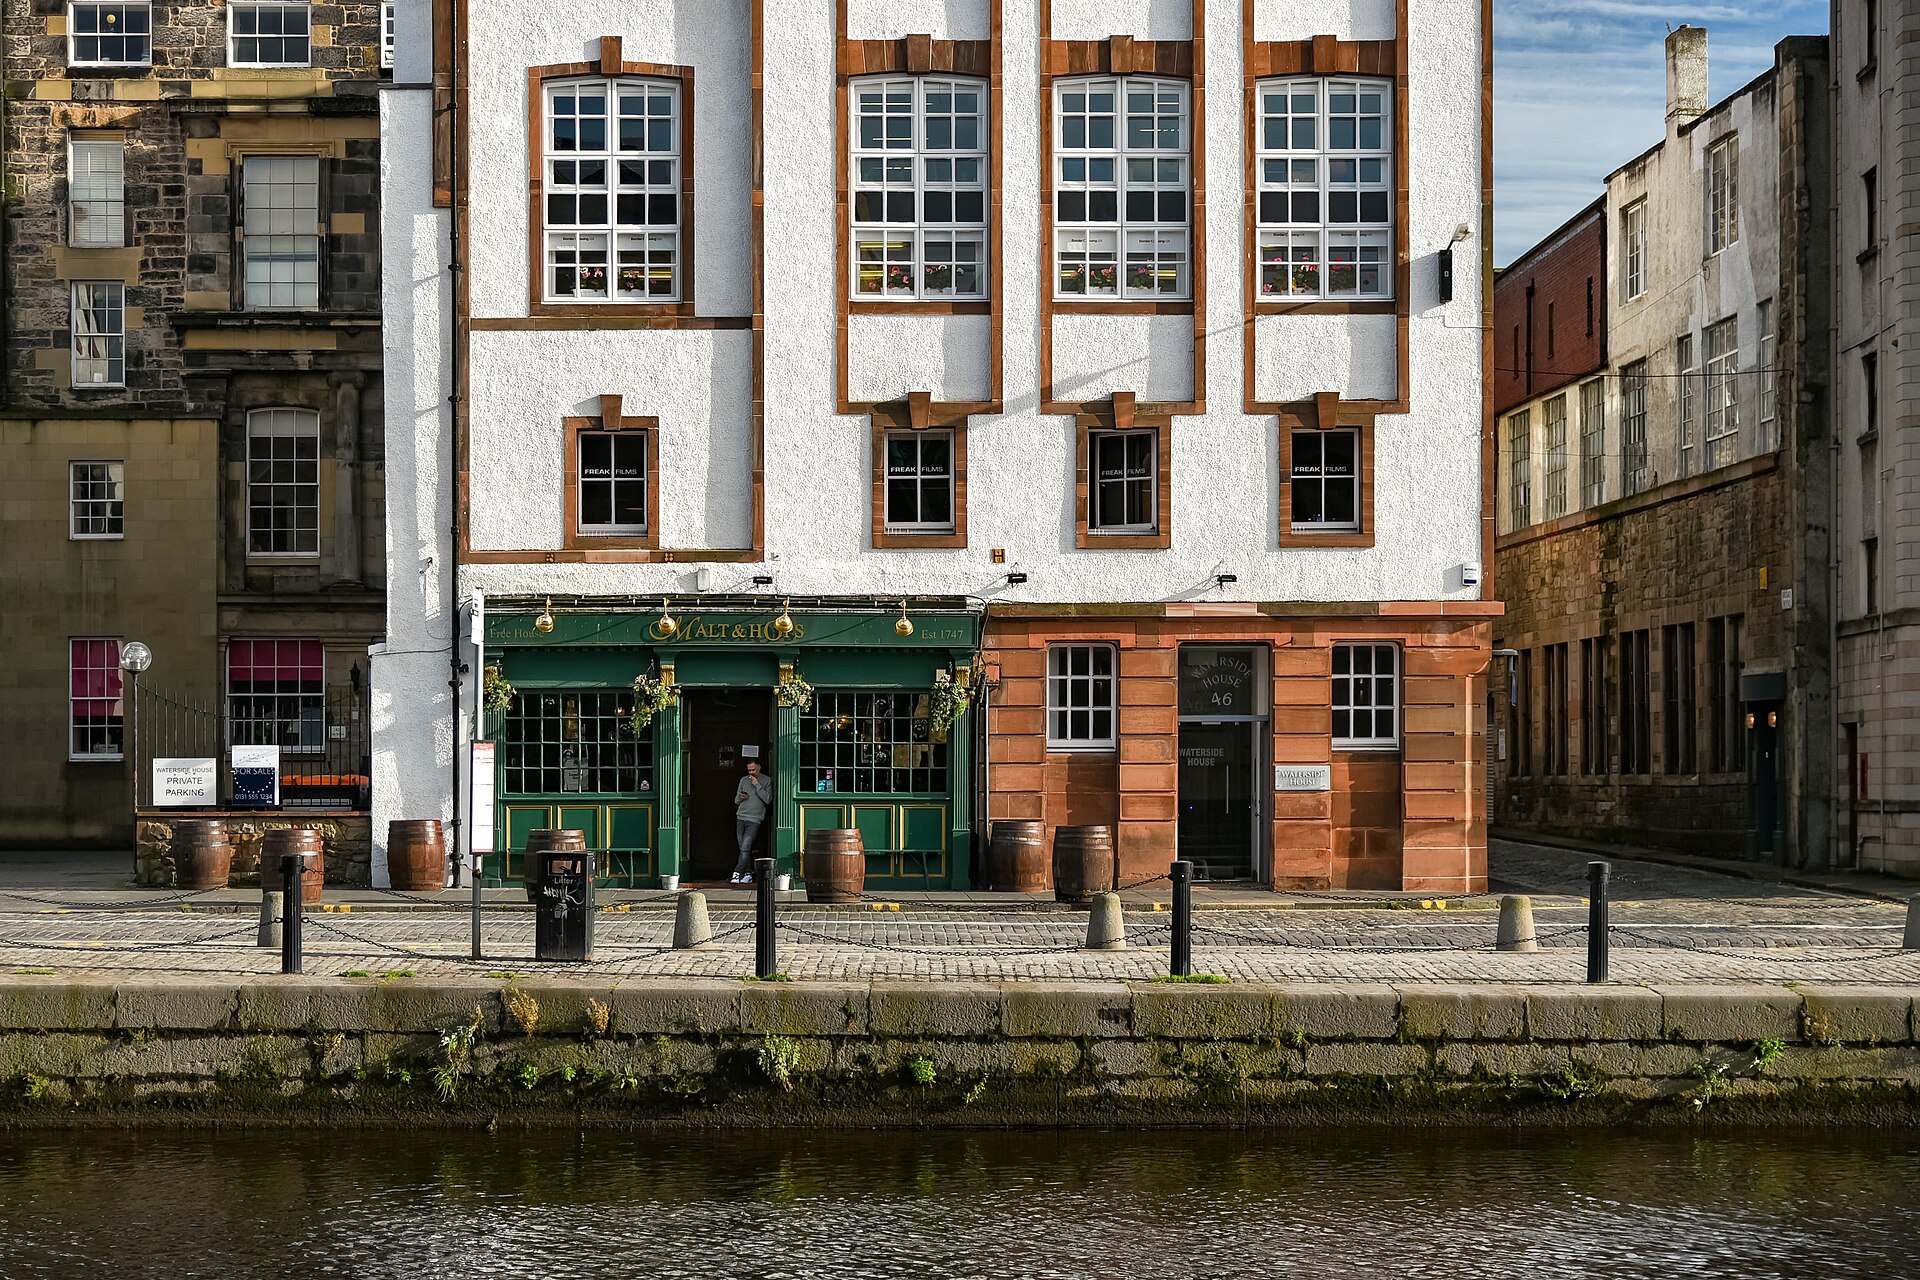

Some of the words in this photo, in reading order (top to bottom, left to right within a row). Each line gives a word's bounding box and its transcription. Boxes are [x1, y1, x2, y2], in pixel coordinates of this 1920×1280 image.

[490, 628, 511, 638] Free
[514, 628, 544, 638] House
[750, 621, 805, 641] HOS
[922, 630, 936, 639] Est
[941, 630, 963, 639] 1747
[1203, 674, 1242, 688] HOUSE
[1212, 692, 1233, 705] 46
[1188, 758, 1215, 766] HOUSE
